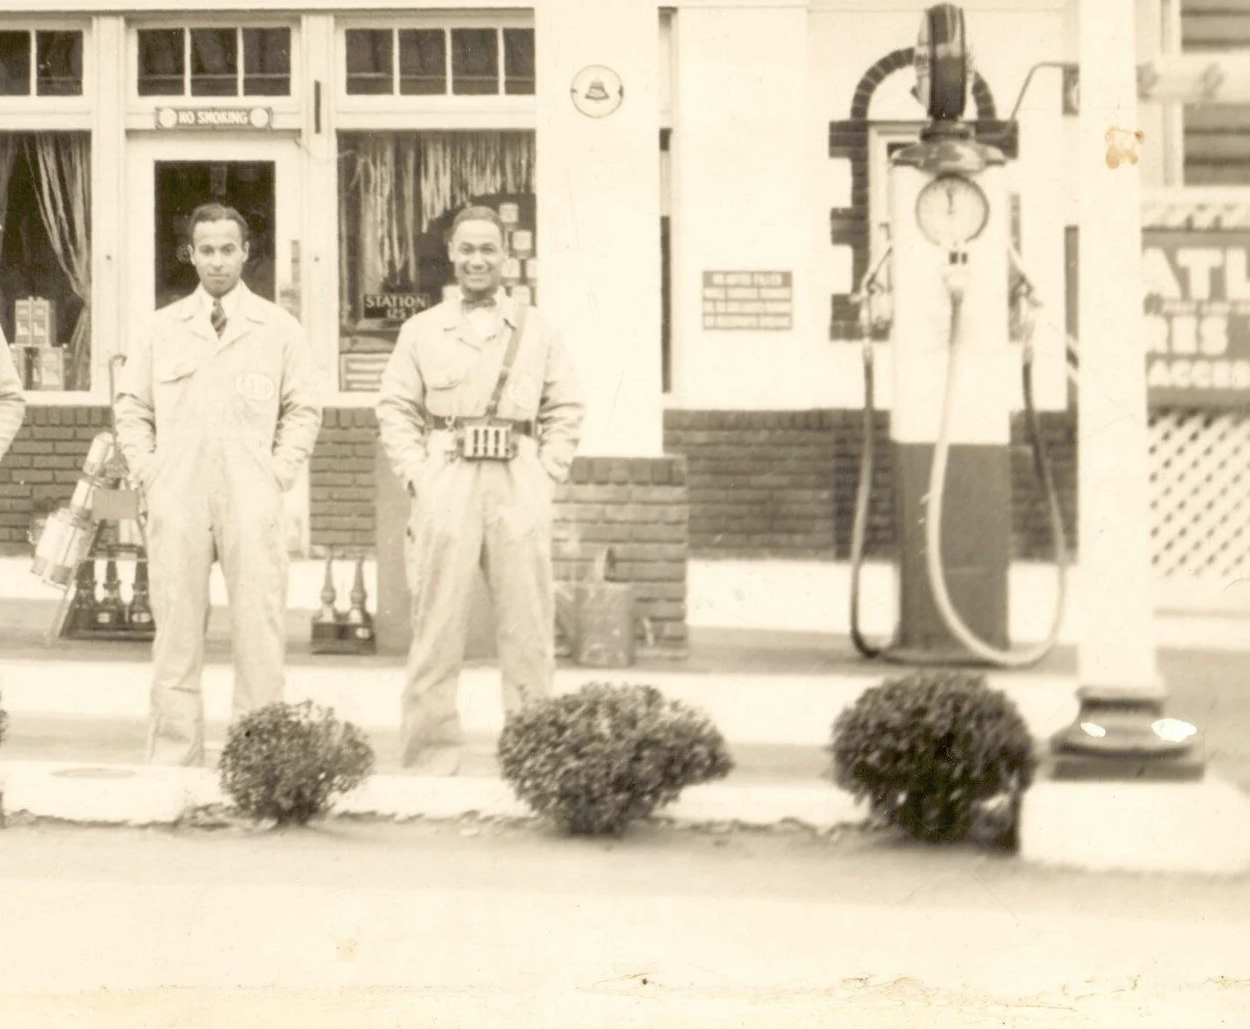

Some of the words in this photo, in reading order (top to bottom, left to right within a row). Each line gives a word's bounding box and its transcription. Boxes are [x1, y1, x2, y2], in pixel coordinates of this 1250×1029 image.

[178, 110, 196, 124] NO
[197, 110, 249, 125] SMOKING
[365, 295, 426, 308] STATION
